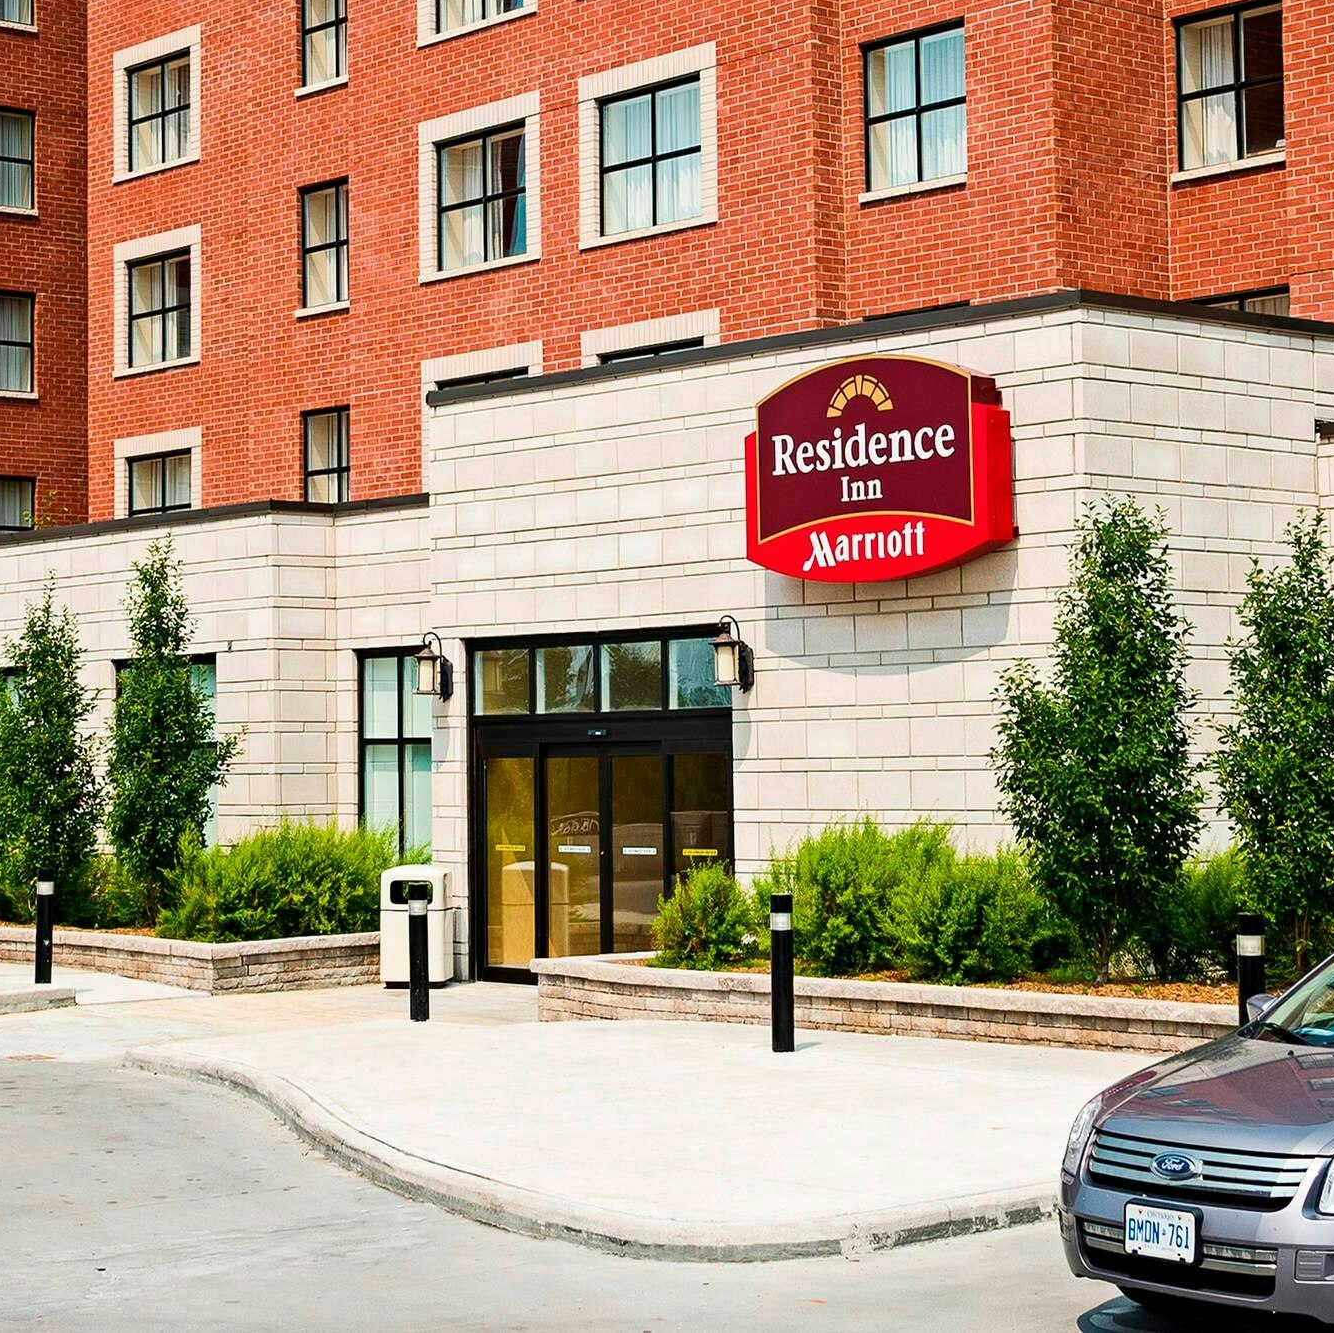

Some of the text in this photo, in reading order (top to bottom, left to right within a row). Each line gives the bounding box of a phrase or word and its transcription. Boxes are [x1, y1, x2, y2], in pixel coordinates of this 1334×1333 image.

[771, 422, 956, 477] Residence
[840, 476, 883, 503] Inn
[802, 520, 926, 572] Marriott
[1161, 1158, 1185, 1171] Ford
